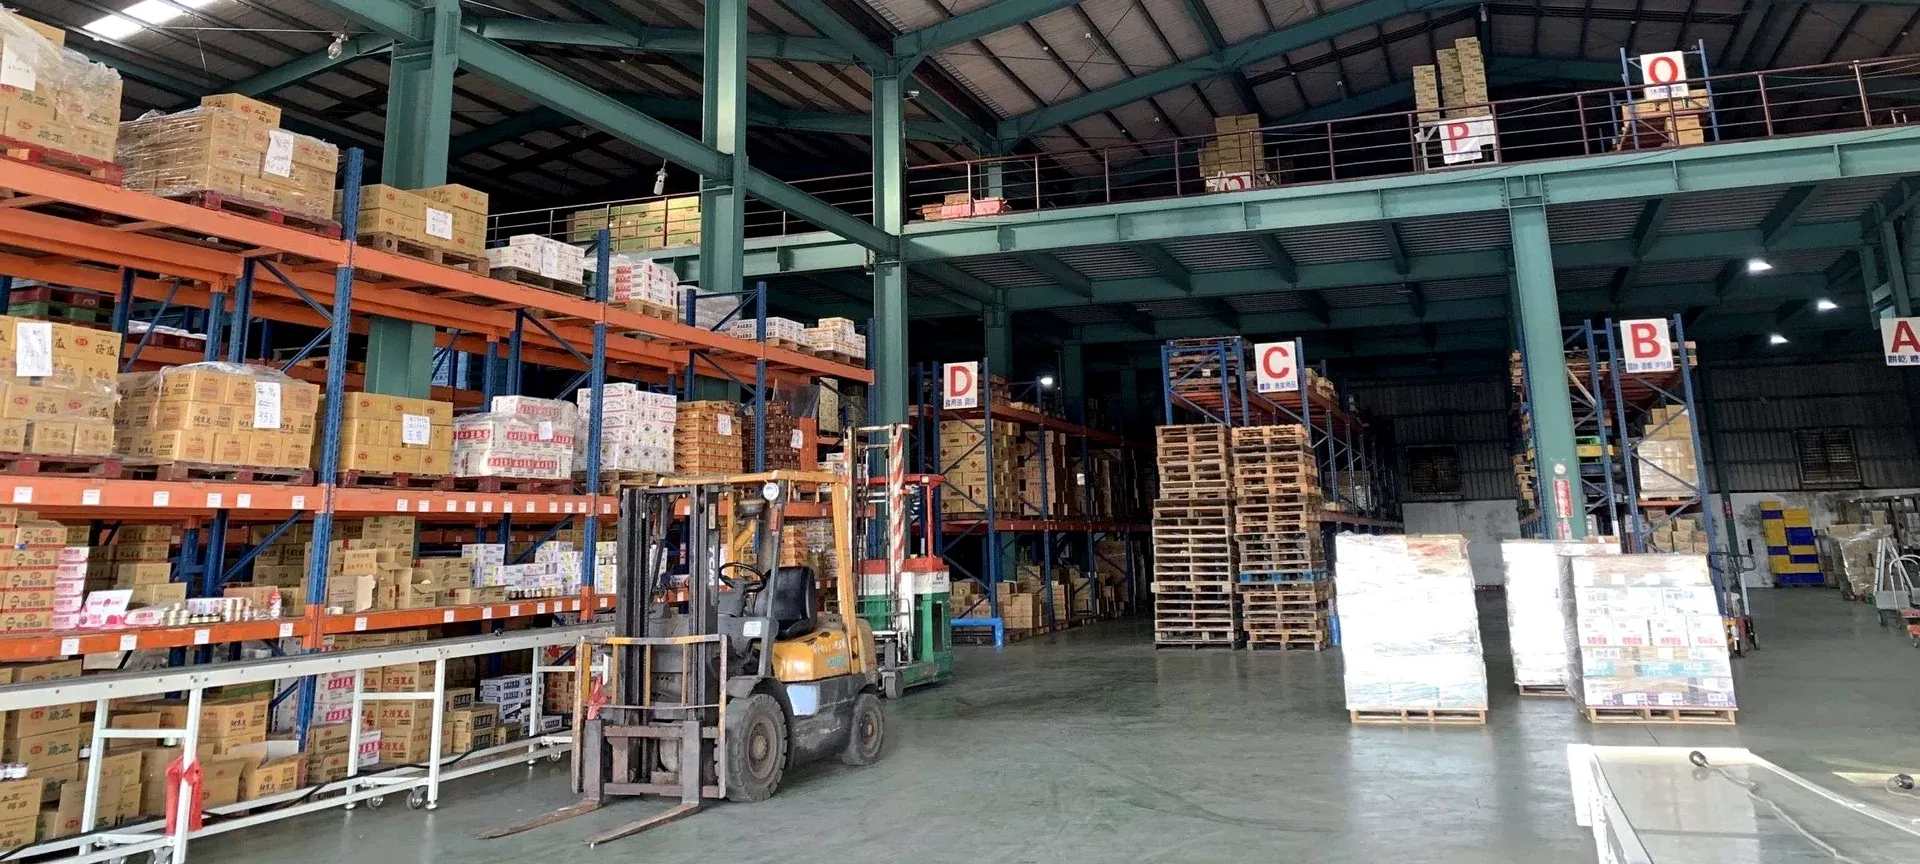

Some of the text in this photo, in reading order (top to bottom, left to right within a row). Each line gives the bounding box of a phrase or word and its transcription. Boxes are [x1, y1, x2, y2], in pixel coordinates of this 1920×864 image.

[1649, 56, 1678, 85] O
[1447, 122, 1469, 151] P
[1630, 323, 1661, 358] B
[1891, 320, 1920, 353] A
[1263, 346, 1290, 379] C
[950, 365, 972, 397] D
